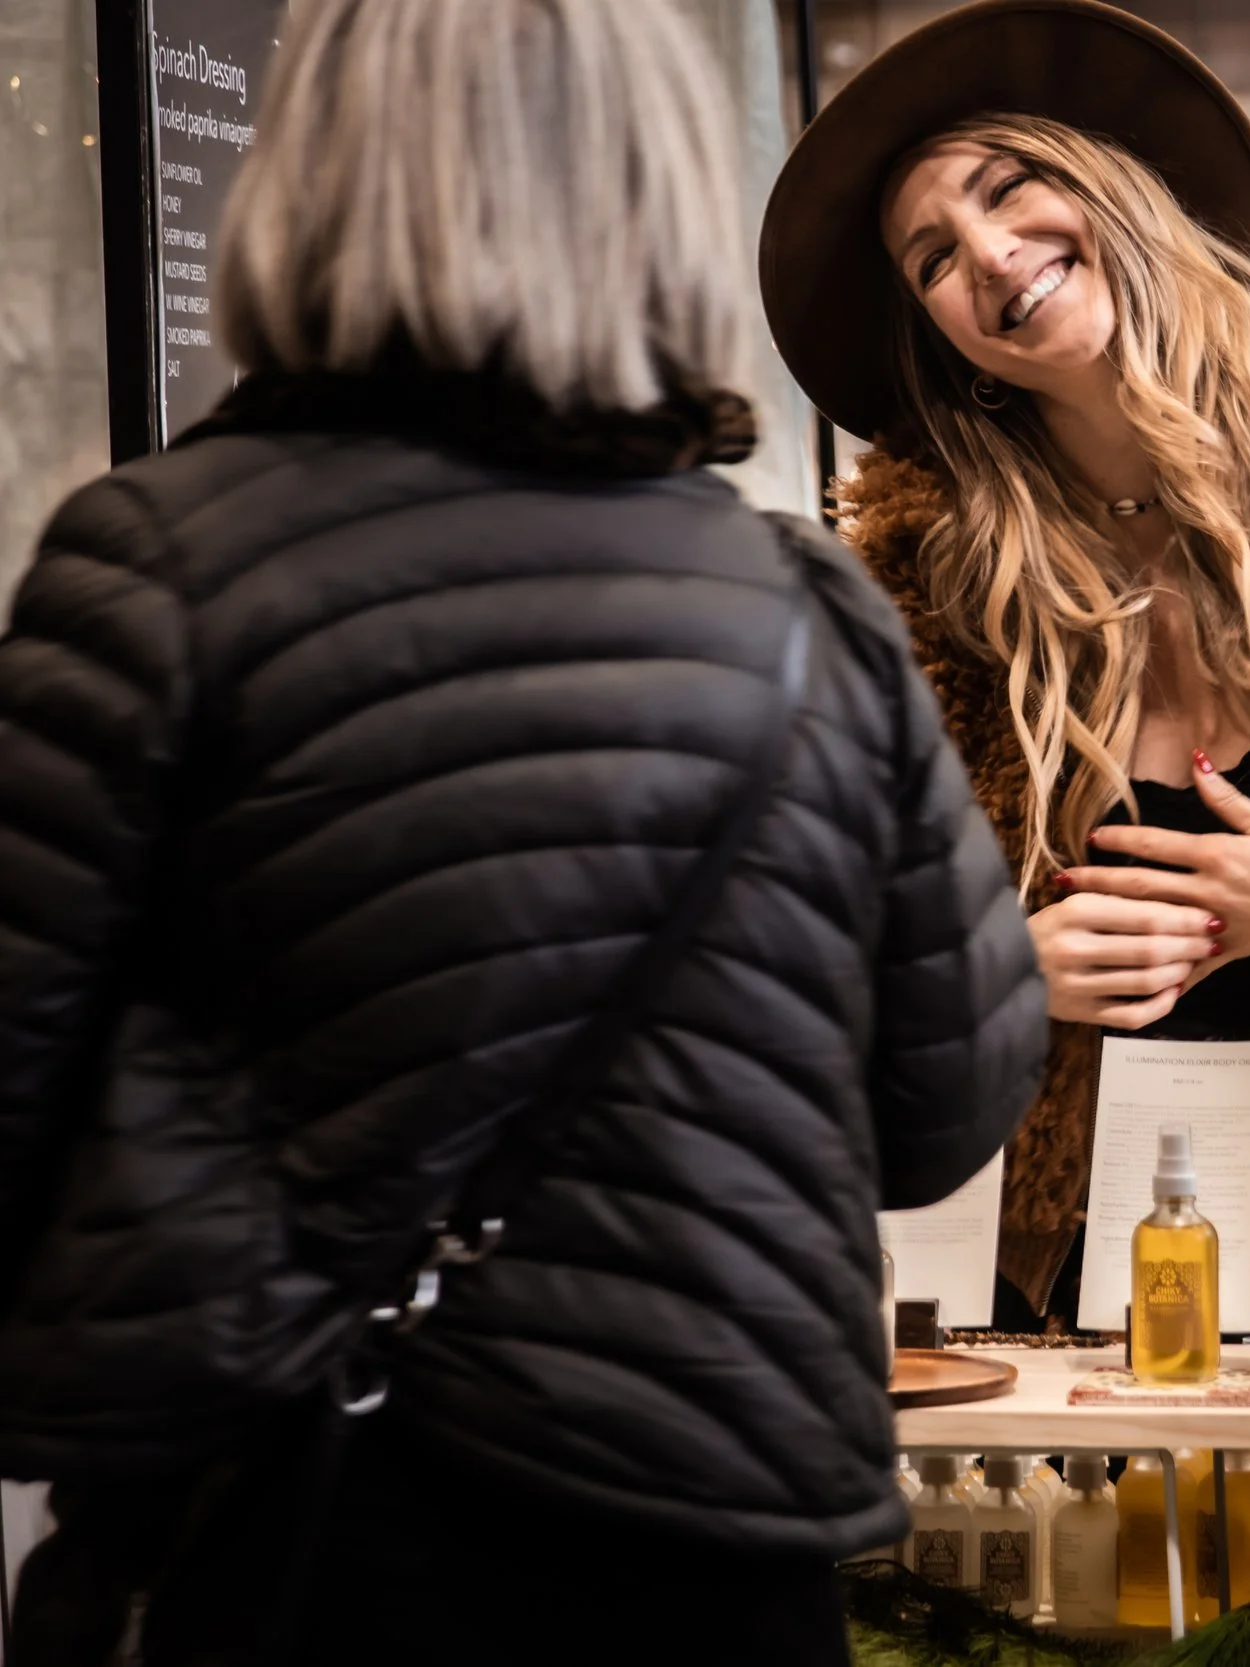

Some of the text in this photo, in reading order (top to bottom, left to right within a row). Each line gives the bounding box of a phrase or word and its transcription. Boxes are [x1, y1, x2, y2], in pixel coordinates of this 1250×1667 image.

[152, 30, 246, 105] Spinach Dressing
[159, 99, 258, 152] moked paprika vinaigrett
[161, 161, 203, 186] SUNFLOWER OIL
[162, 194, 182, 214] HONEY
[163, 227, 207, 249] SHERRY VINEGAR
[165, 260, 207, 282] MUSTARD SEEDS
[173, 294, 187, 312] WINE
[187, 296, 210, 315] VINEGAR
[166, 327, 212, 347] SMOKED PAPRIKA
[167, 359, 181, 378] SALT
[1125, 1055, 1185, 1066] ILLUMINATION
[1186, 1057, 1211, 1067] ELIXIR
[1213, 1057, 1237, 1067] BODY
